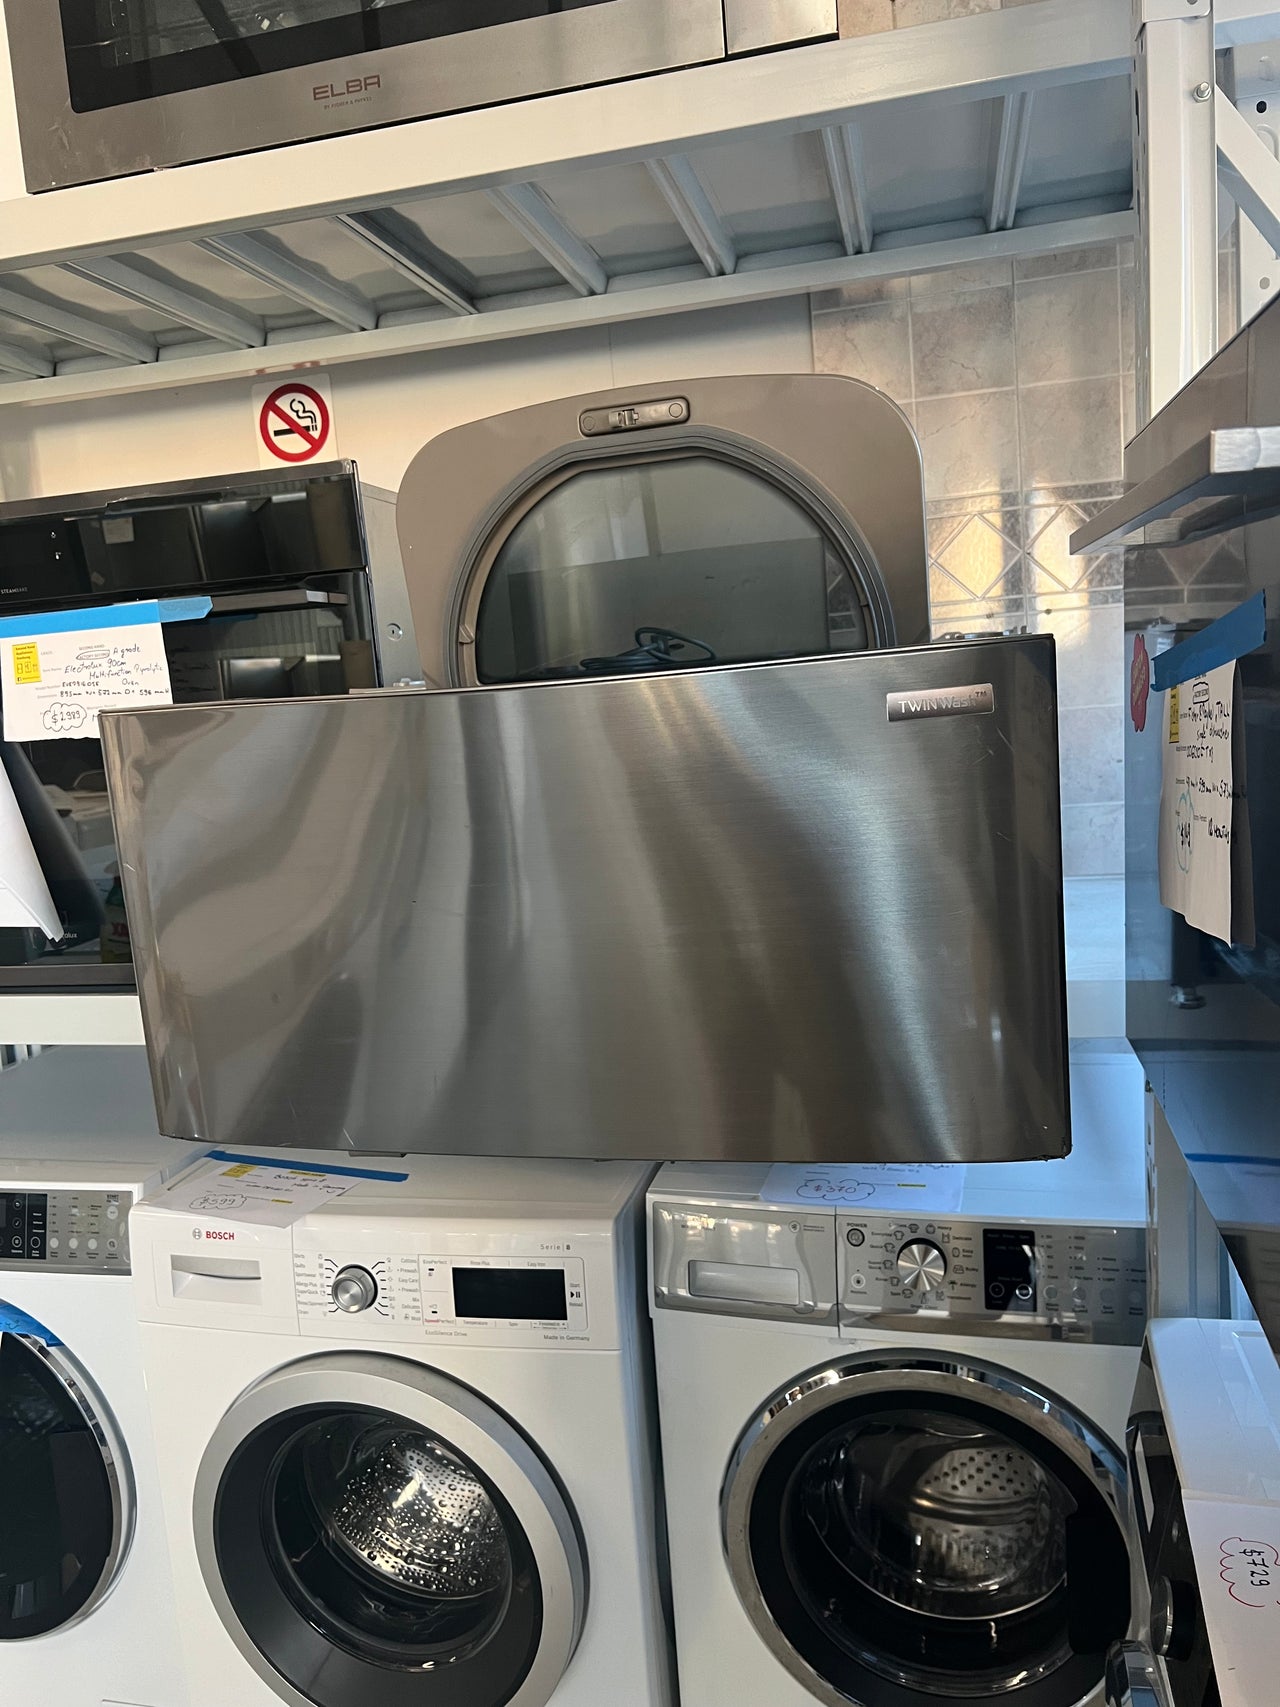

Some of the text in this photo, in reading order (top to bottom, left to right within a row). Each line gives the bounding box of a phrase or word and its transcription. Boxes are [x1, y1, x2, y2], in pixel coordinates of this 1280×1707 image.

[313, 74, 381, 101] ELBA
[205, 1230, 235, 1241] BOSCH
[540, 1243, 561, 1251] Serie
[565, 1335, 591, 1343] Germany
[1238, 1548, 1271, 1588] $729
